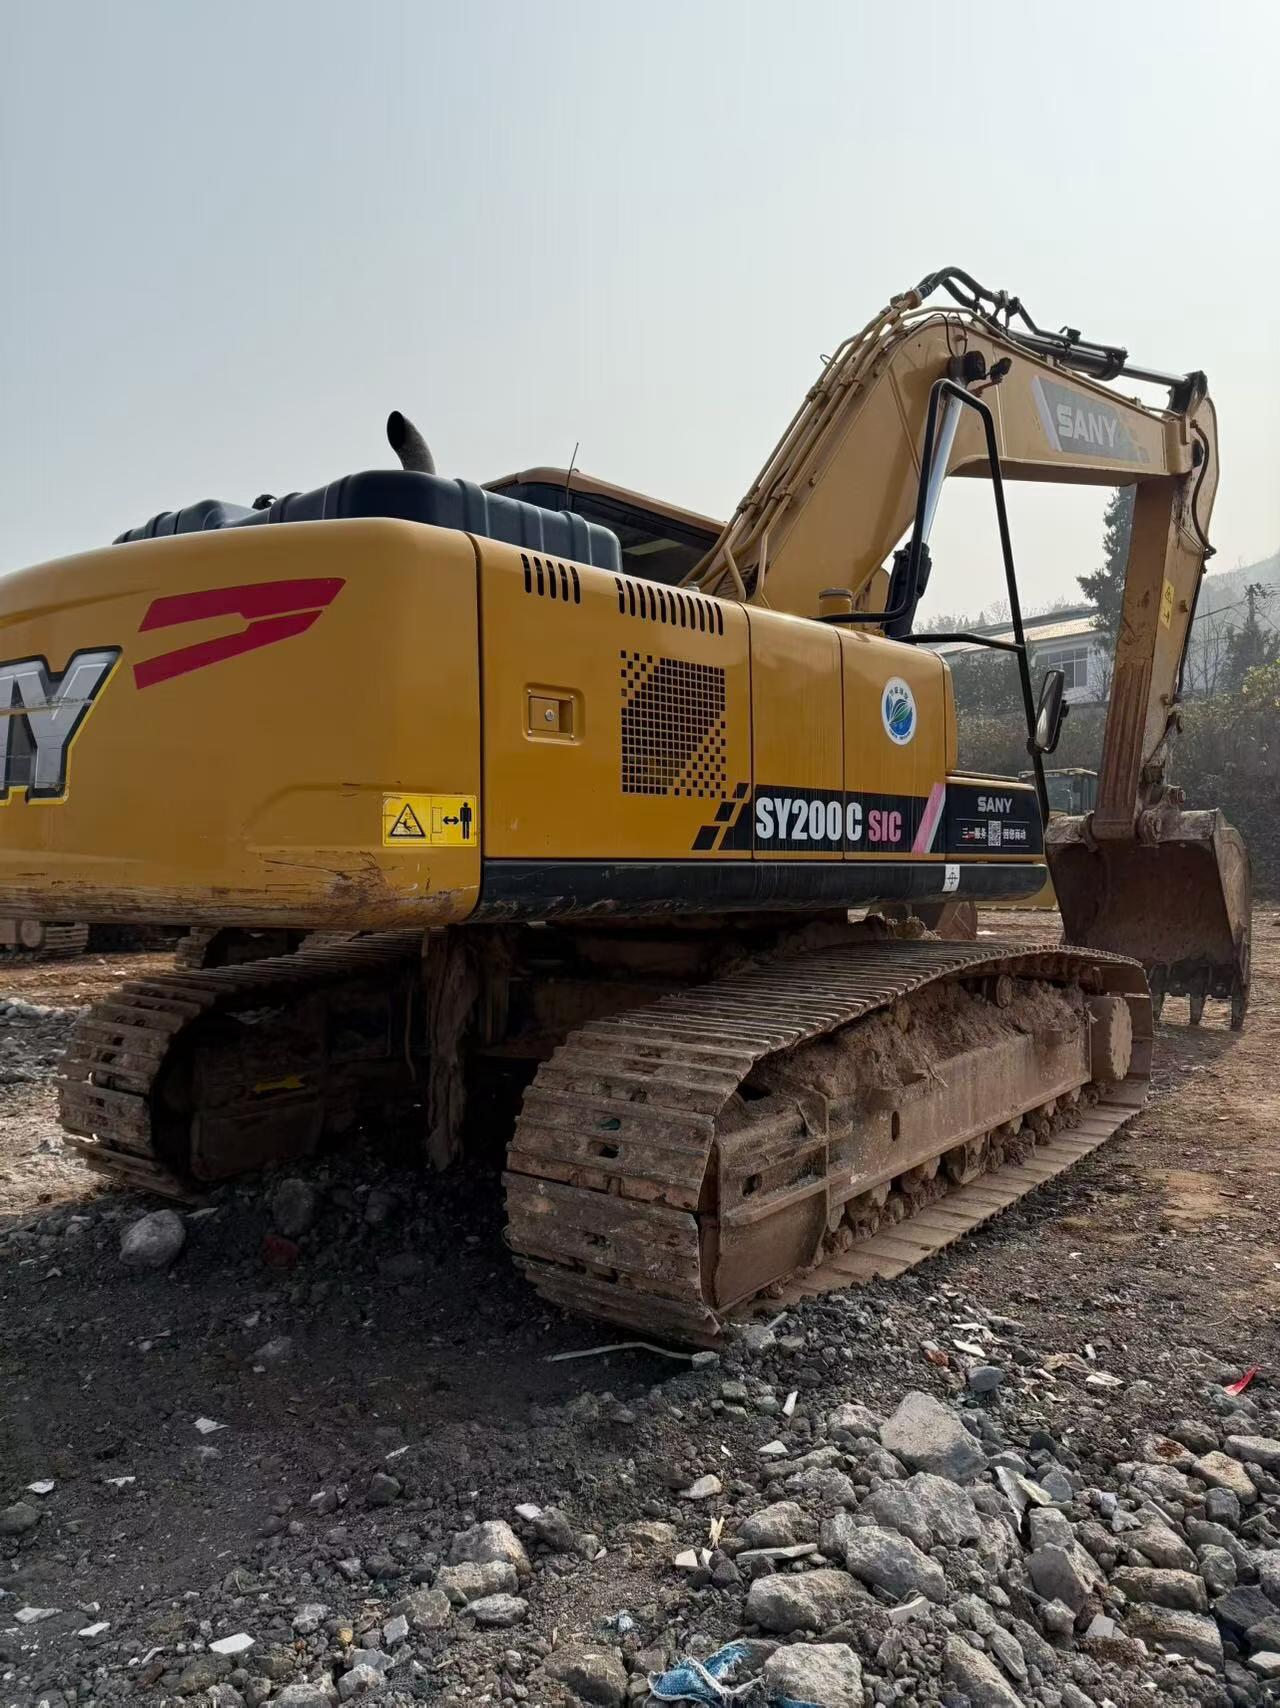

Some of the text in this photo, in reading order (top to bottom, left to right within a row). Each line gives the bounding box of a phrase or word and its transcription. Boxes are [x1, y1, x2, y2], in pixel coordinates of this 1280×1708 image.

[1056, 403, 1118, 448] SANY
[755, 796, 902, 843] SY200C SIC
[977, 796, 1013, 814] SANY
